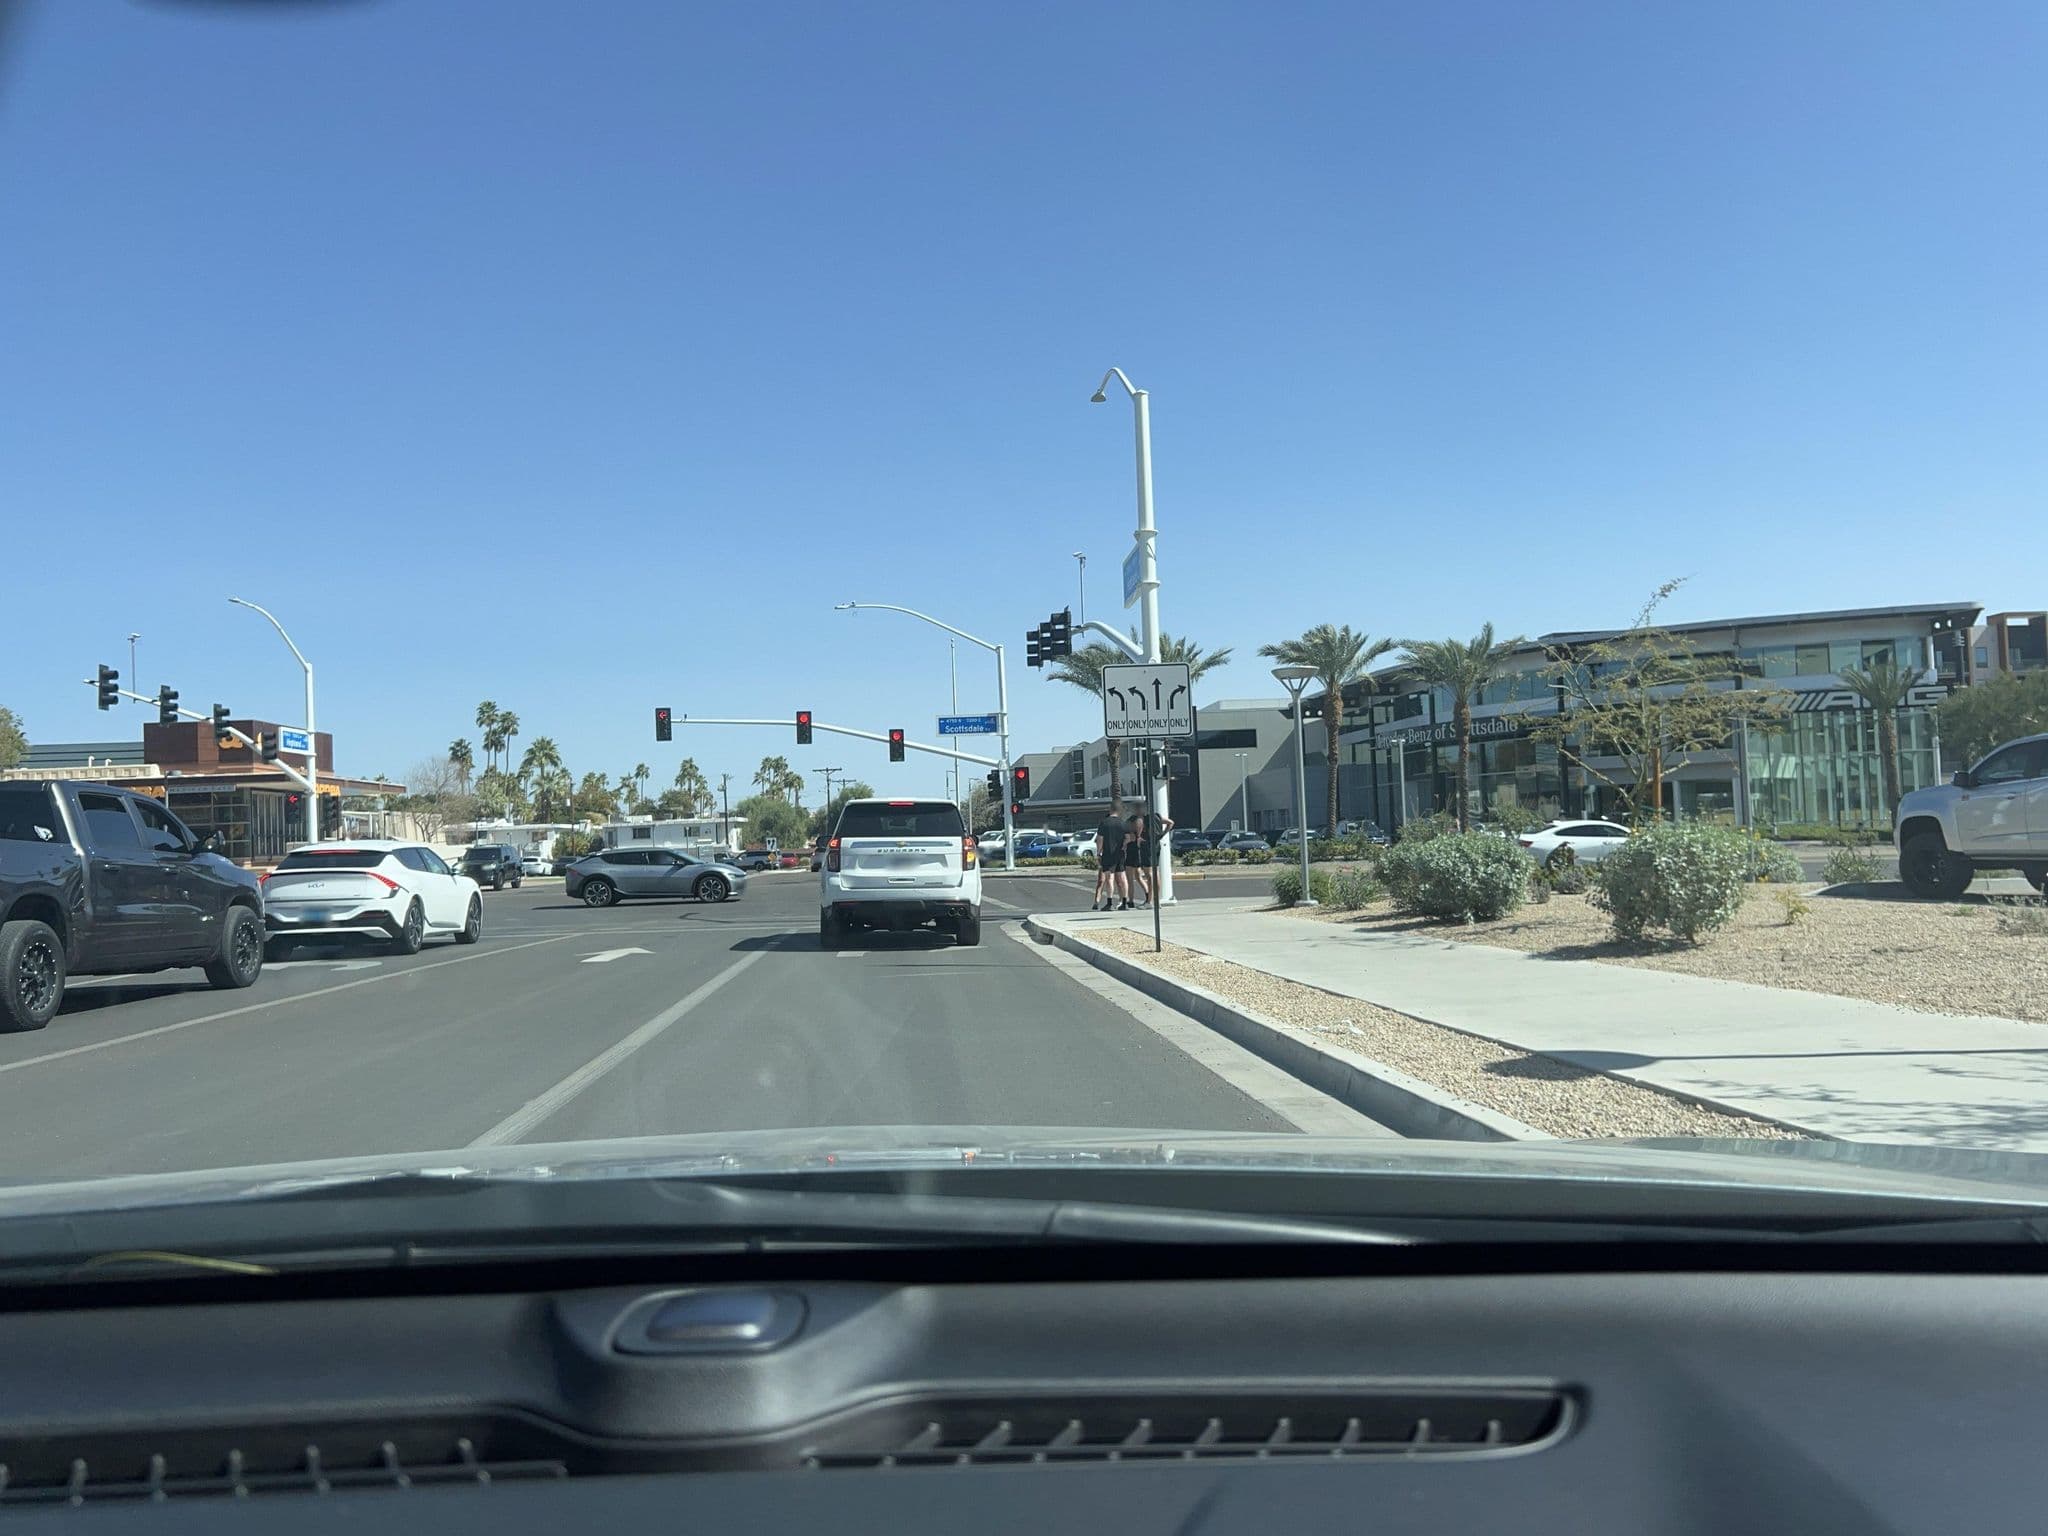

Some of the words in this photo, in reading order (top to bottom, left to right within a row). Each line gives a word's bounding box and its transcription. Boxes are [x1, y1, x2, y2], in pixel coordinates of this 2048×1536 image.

[1817, 686, 1948, 711] AG
[945, 724, 984, 733] Scottsdale
[1107, 720, 1126, 730] ONLY
[1128, 719, 1147, 729] ONLY
[1149, 718, 1168, 728] ONLY
[1169, 717, 1188, 727] ONLY
[1434, 725, 1447, 740] of
[1449, 717, 1518, 739] Sttsdale
